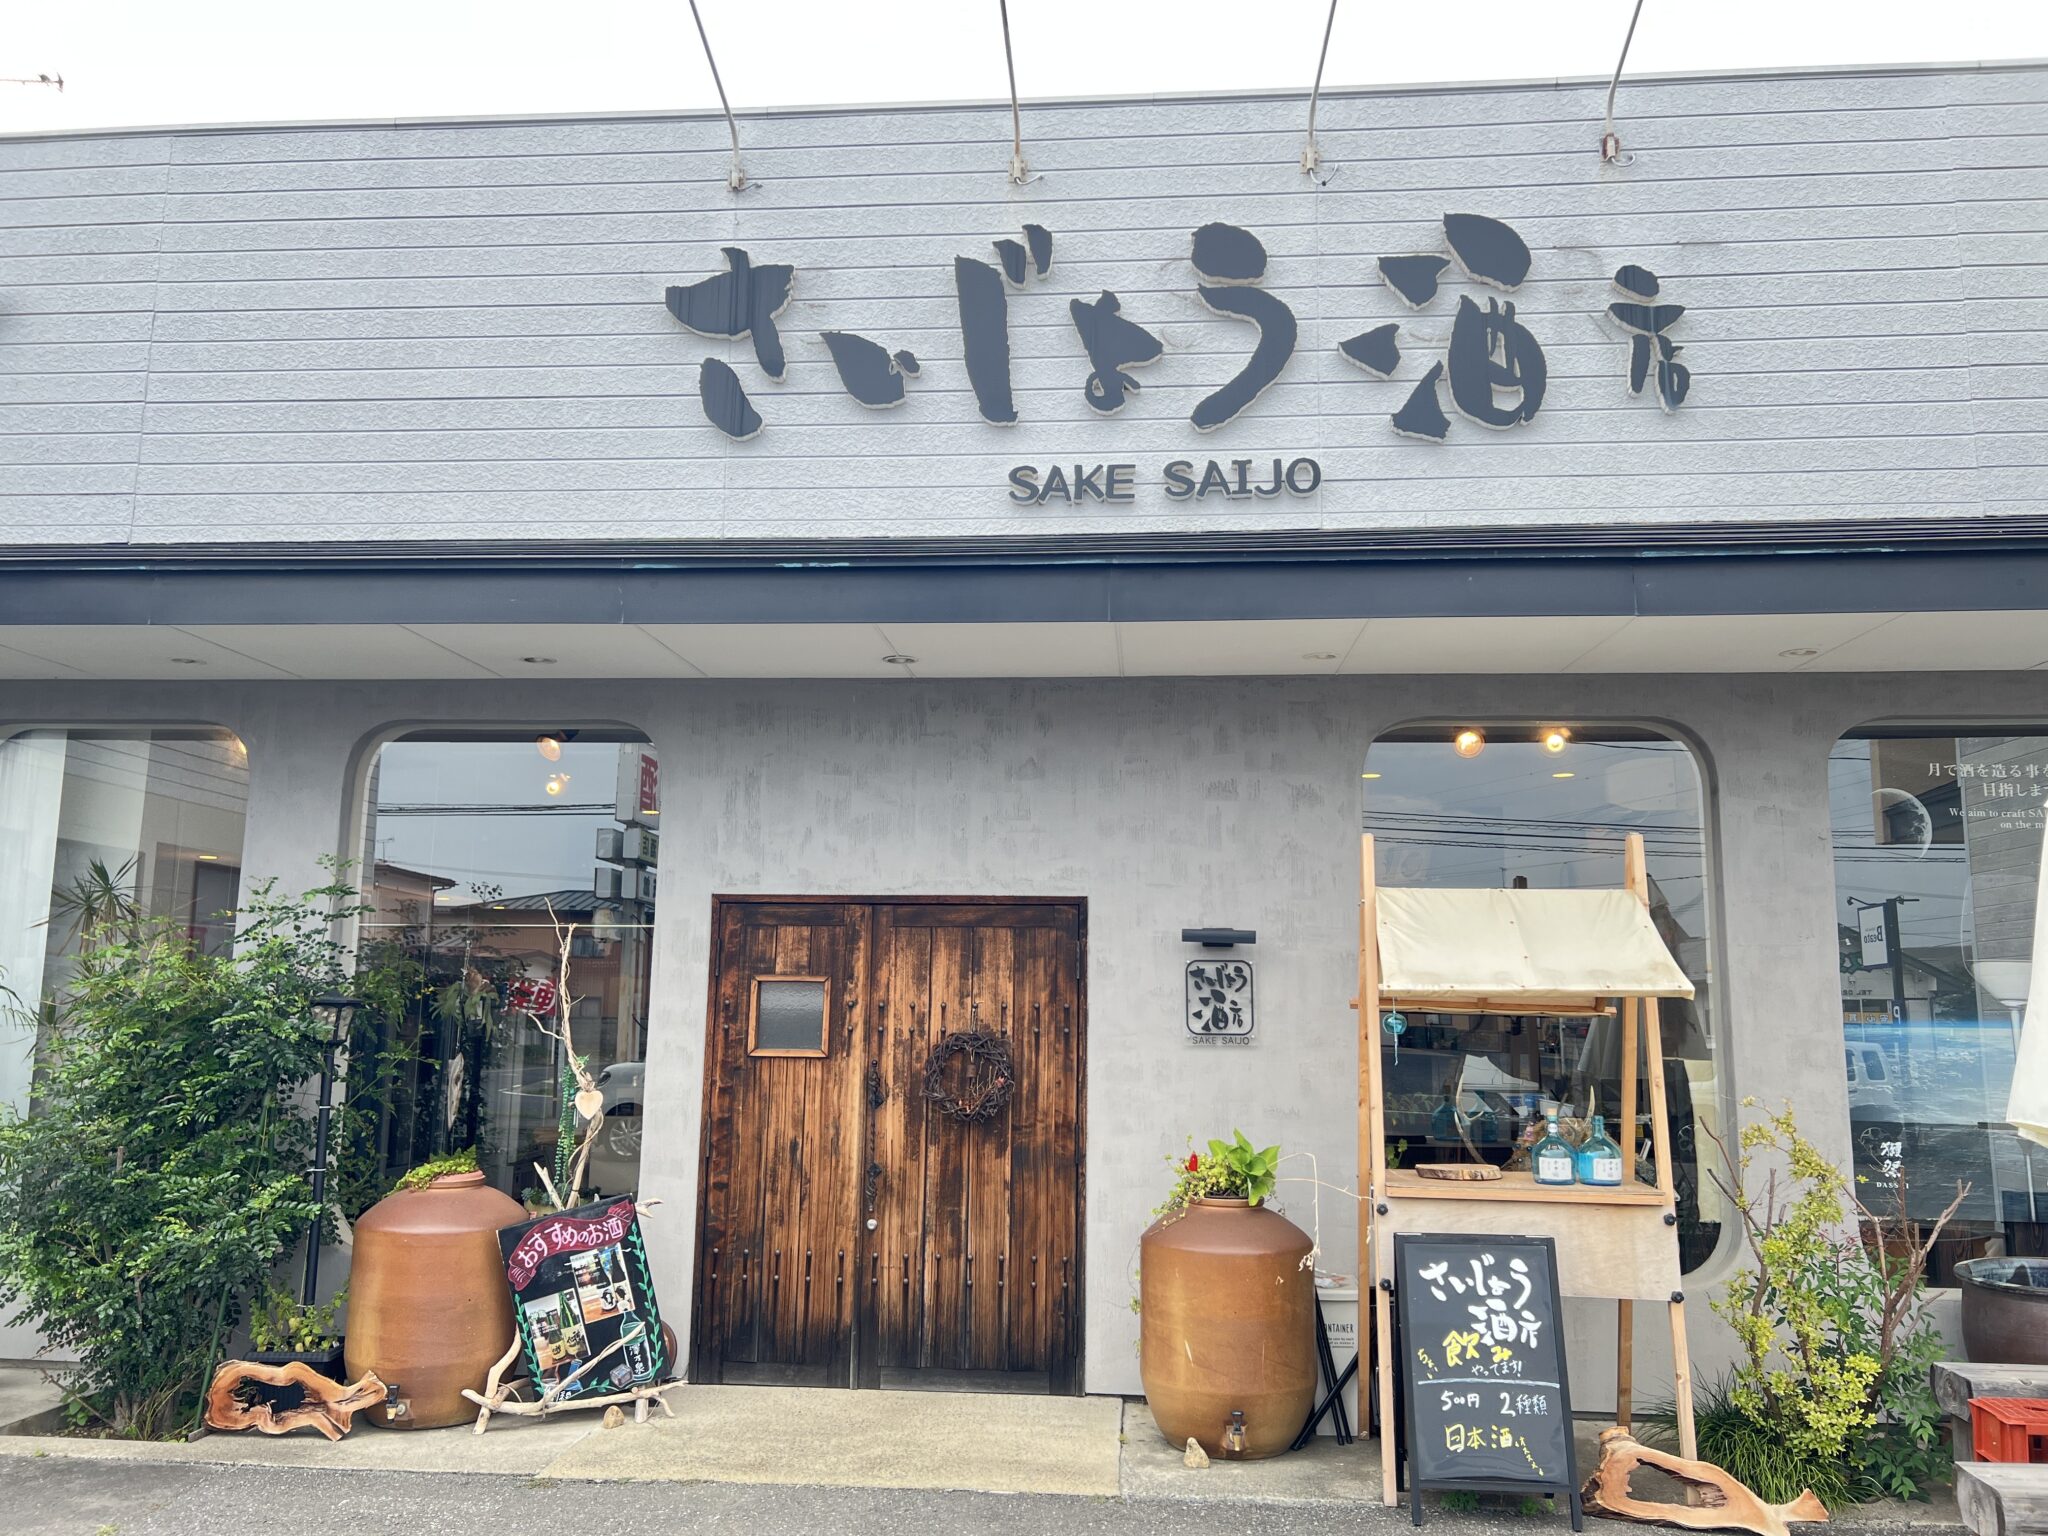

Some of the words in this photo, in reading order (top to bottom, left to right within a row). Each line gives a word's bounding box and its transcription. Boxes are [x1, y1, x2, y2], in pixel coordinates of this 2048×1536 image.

[1009, 463, 1137, 505] SAKE
[1165, 456, 1323, 501] SAIJO
[1983, 783, 2048, 798] 目指しま
[1949, 807, 1966, 818] We
[1968, 807, 1986, 818] aim
[1989, 809, 1999, 818] to
[2002, 808, 2026, 819] craft
[2028, 808, 2047, 819] SA
[2000, 822, 2012, 830] on
[2015, 820, 2032, 830] the
[1192, 1036, 1217, 1046] SAKE
[1222, 1036, 1250, 1046] SAIJO
[1876, 1181, 1910, 1190] DASSI
[517, 1217, 624, 1269] おすすめのお酒
[1418, 1253, 1533, 1310] さいじょう
[1440, 1390, 1480, 1411] 500円
[1445, 1423, 1513, 1453] 日本酒
